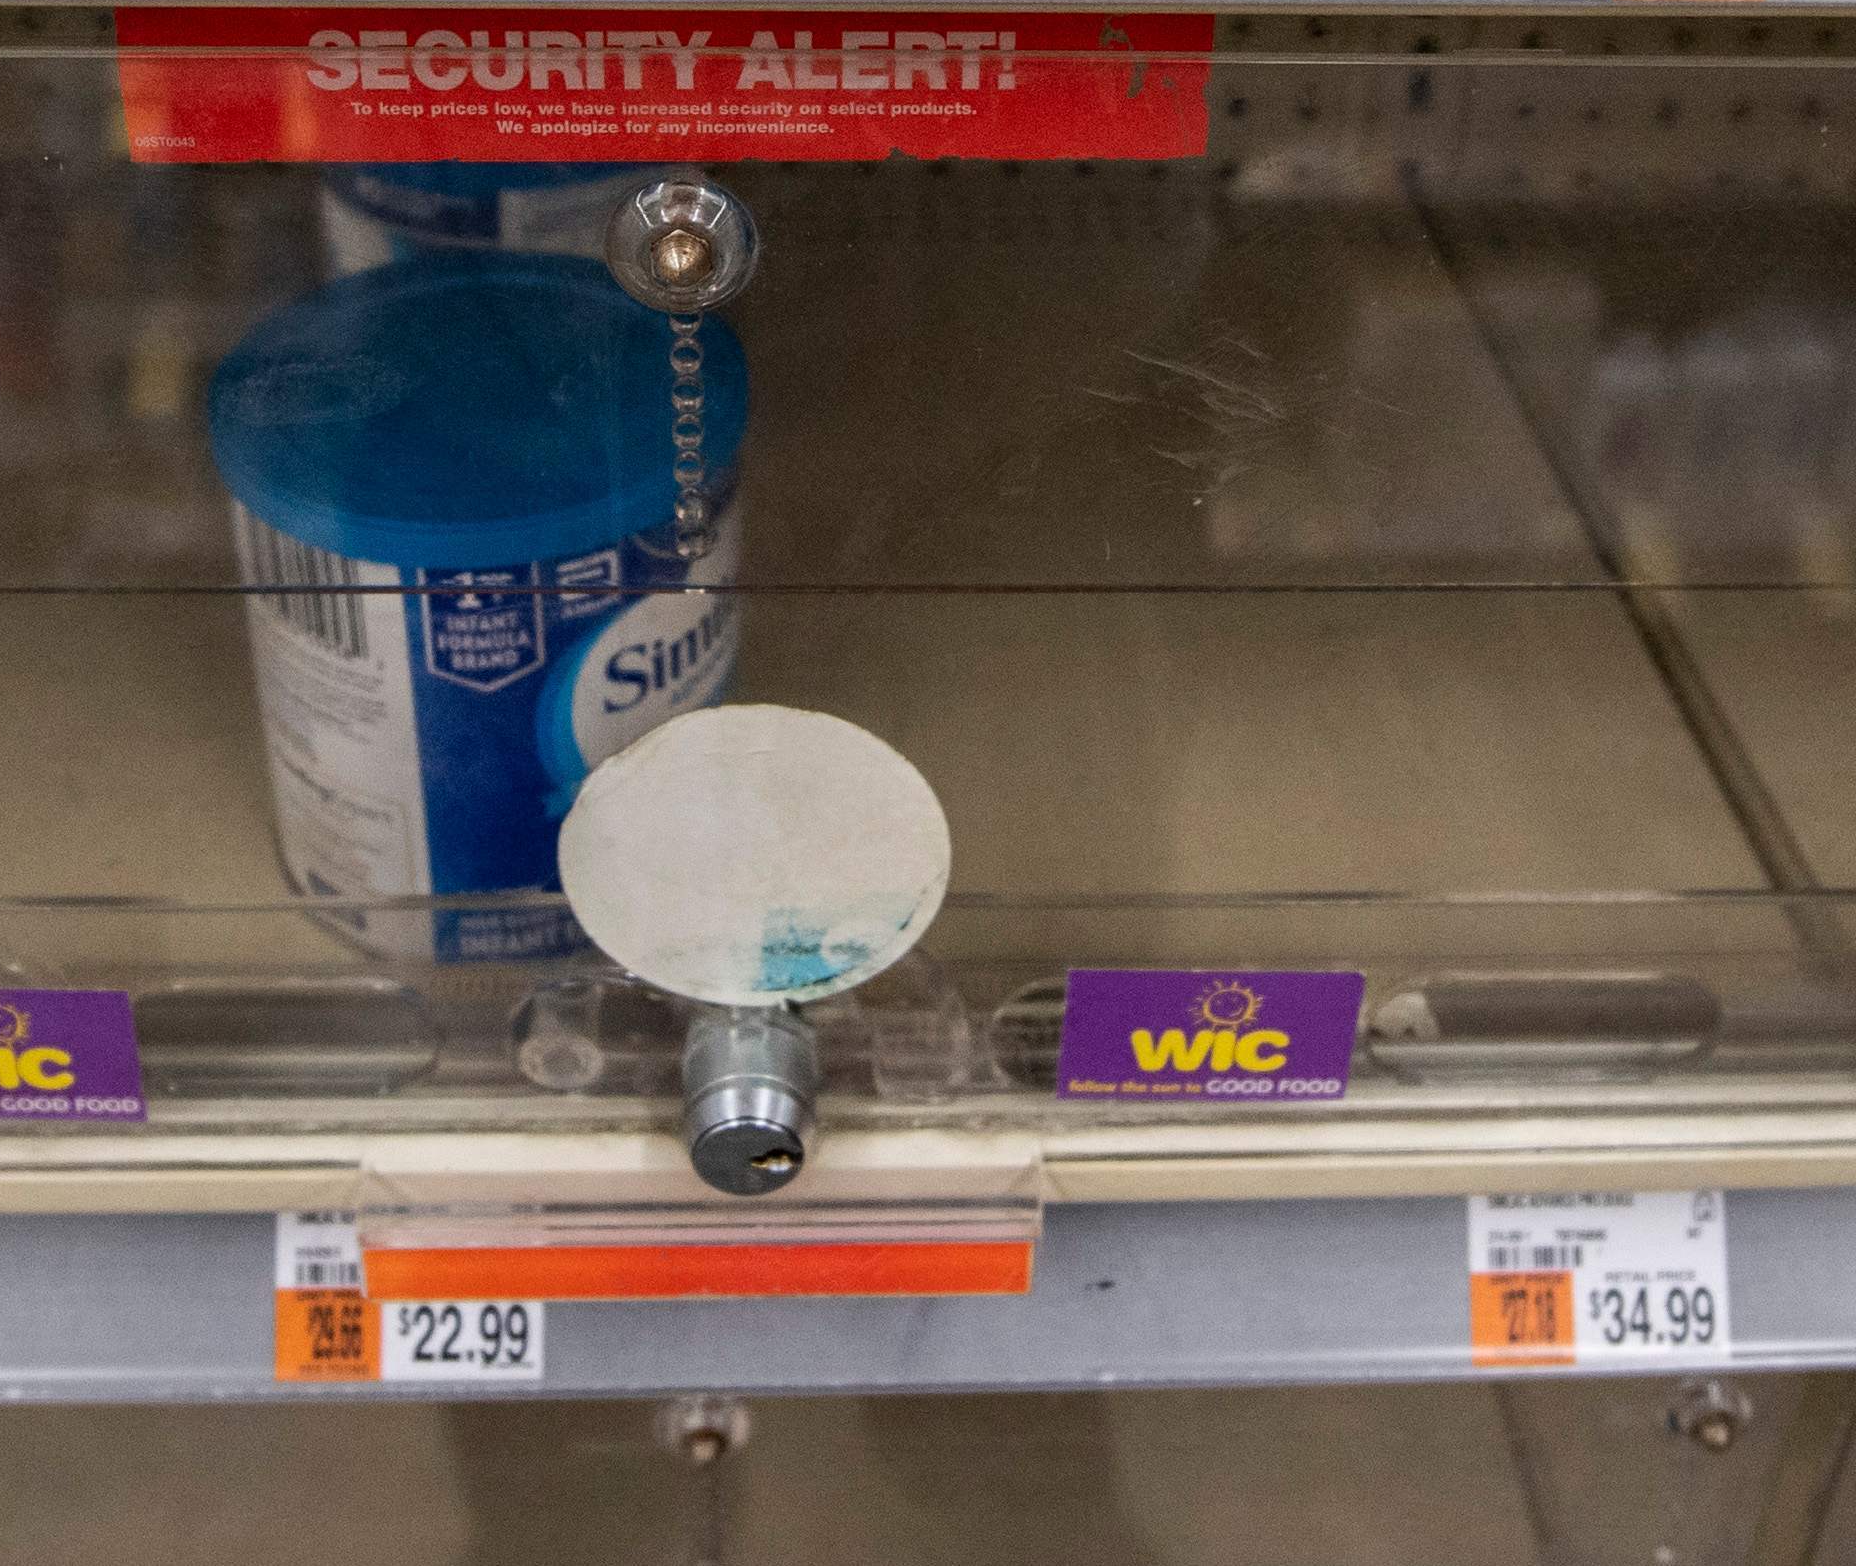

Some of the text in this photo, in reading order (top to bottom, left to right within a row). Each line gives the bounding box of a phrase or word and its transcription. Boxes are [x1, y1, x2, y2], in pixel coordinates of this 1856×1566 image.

[306, 30, 1016, 91] SECURITY ALERT!
[351, 101, 977, 118] To keep prices low, we have increased security on select products.
[497, 120, 834, 137] We apologize for any inconvenience.
[1206, 1079, 1342, 1094] GOOD FOOD
[400, 1305, 529, 1363] $22.99
[1590, 1286, 1715, 1345] $34.99
